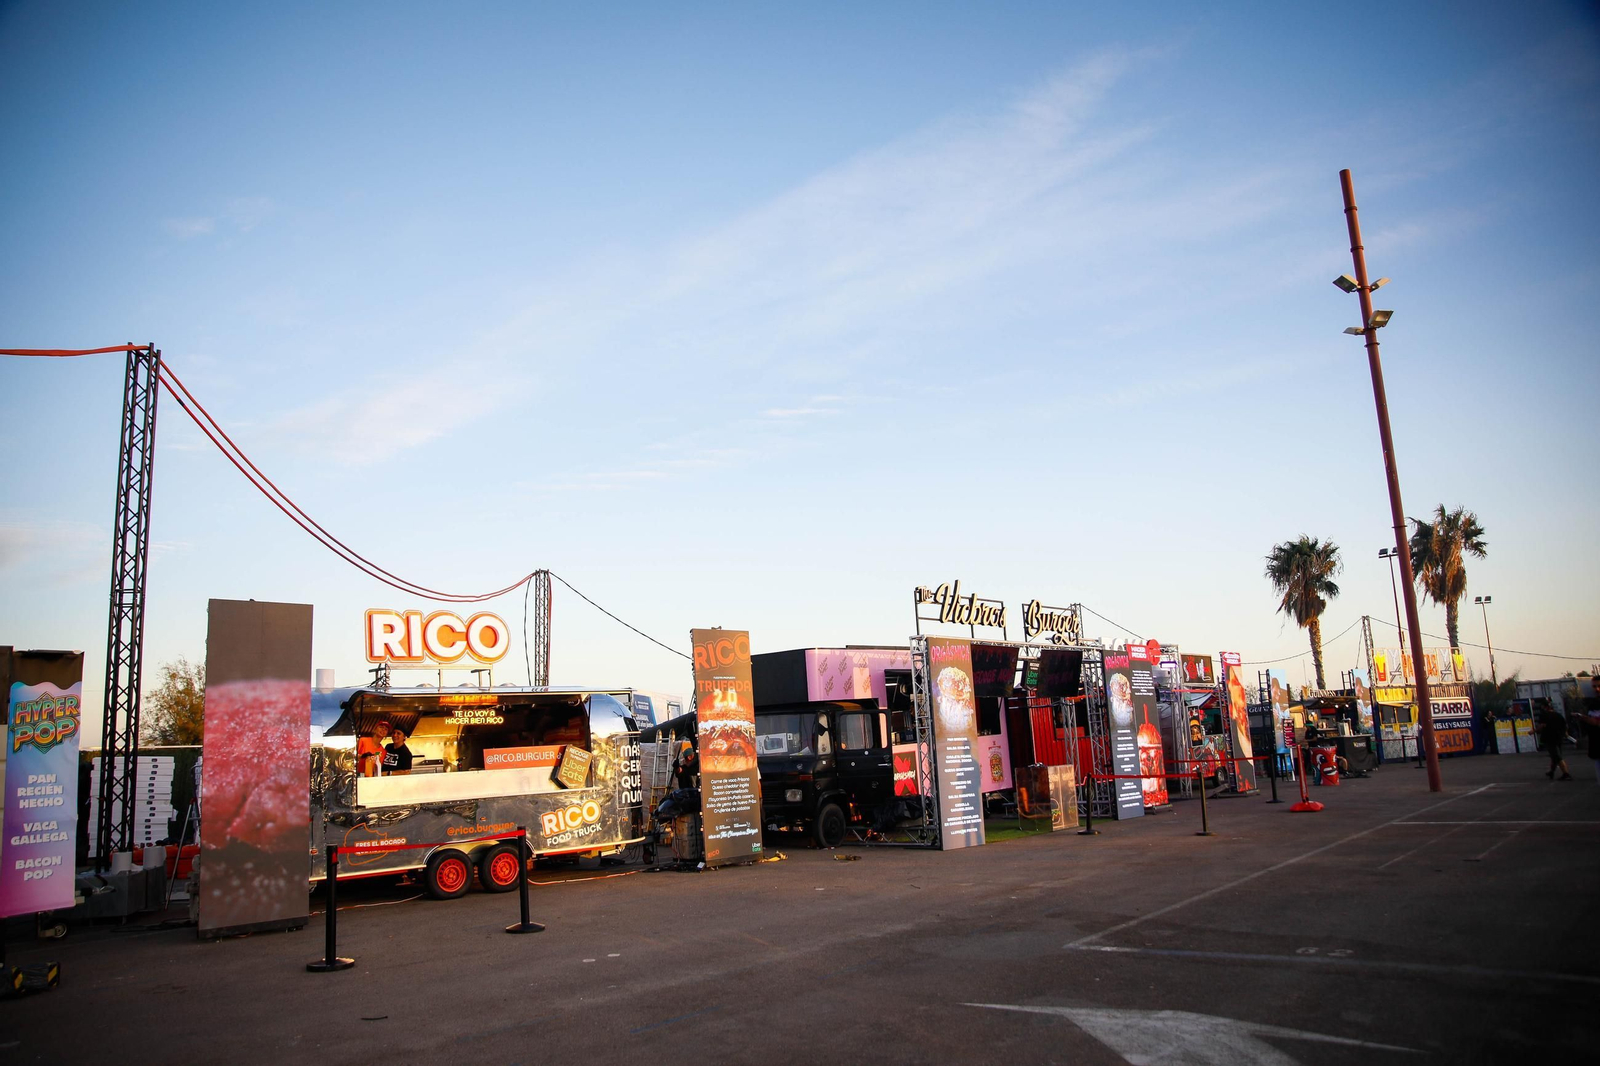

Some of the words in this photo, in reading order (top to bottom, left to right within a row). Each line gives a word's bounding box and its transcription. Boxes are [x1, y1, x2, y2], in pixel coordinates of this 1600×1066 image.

[1026, 599, 1080, 645] Burger
[368, 611, 510, 659] RICO
[694, 636, 750, 671] RICO
[1401, 653, 1438, 678] PATAS
[698, 680, 752, 692] TRUFADA
[714, 688, 738, 707] 2.0
[14, 695, 80, 724] HYPER
[1432, 702, 1471, 714] BARRA
[14, 717, 77, 752] POP
[486, 751, 555, 764] @RICO.BURGUER
[564, 758, 586, 772] Uber
[620, 760, 641, 773] CER
[28, 774, 56, 784] PAN
[562, 767, 583, 782] Eats
[621, 775, 641, 788] QUE
[17, 784, 63, 796] RECIÉN
[622, 790, 642, 803] NUN
[19, 797, 64, 808] HECHO
[542, 800, 600, 835] RICO
[24, 821, 58, 832] VACA
[446, 822, 514, 836] @rico.burguer
[11, 832, 68, 845] GALLEGA
[547, 832, 571, 846] FOOD
[574, 823, 602, 838] TRUCK
[15, 856, 62, 870] BACON
[24, 869, 53, 880] POP
